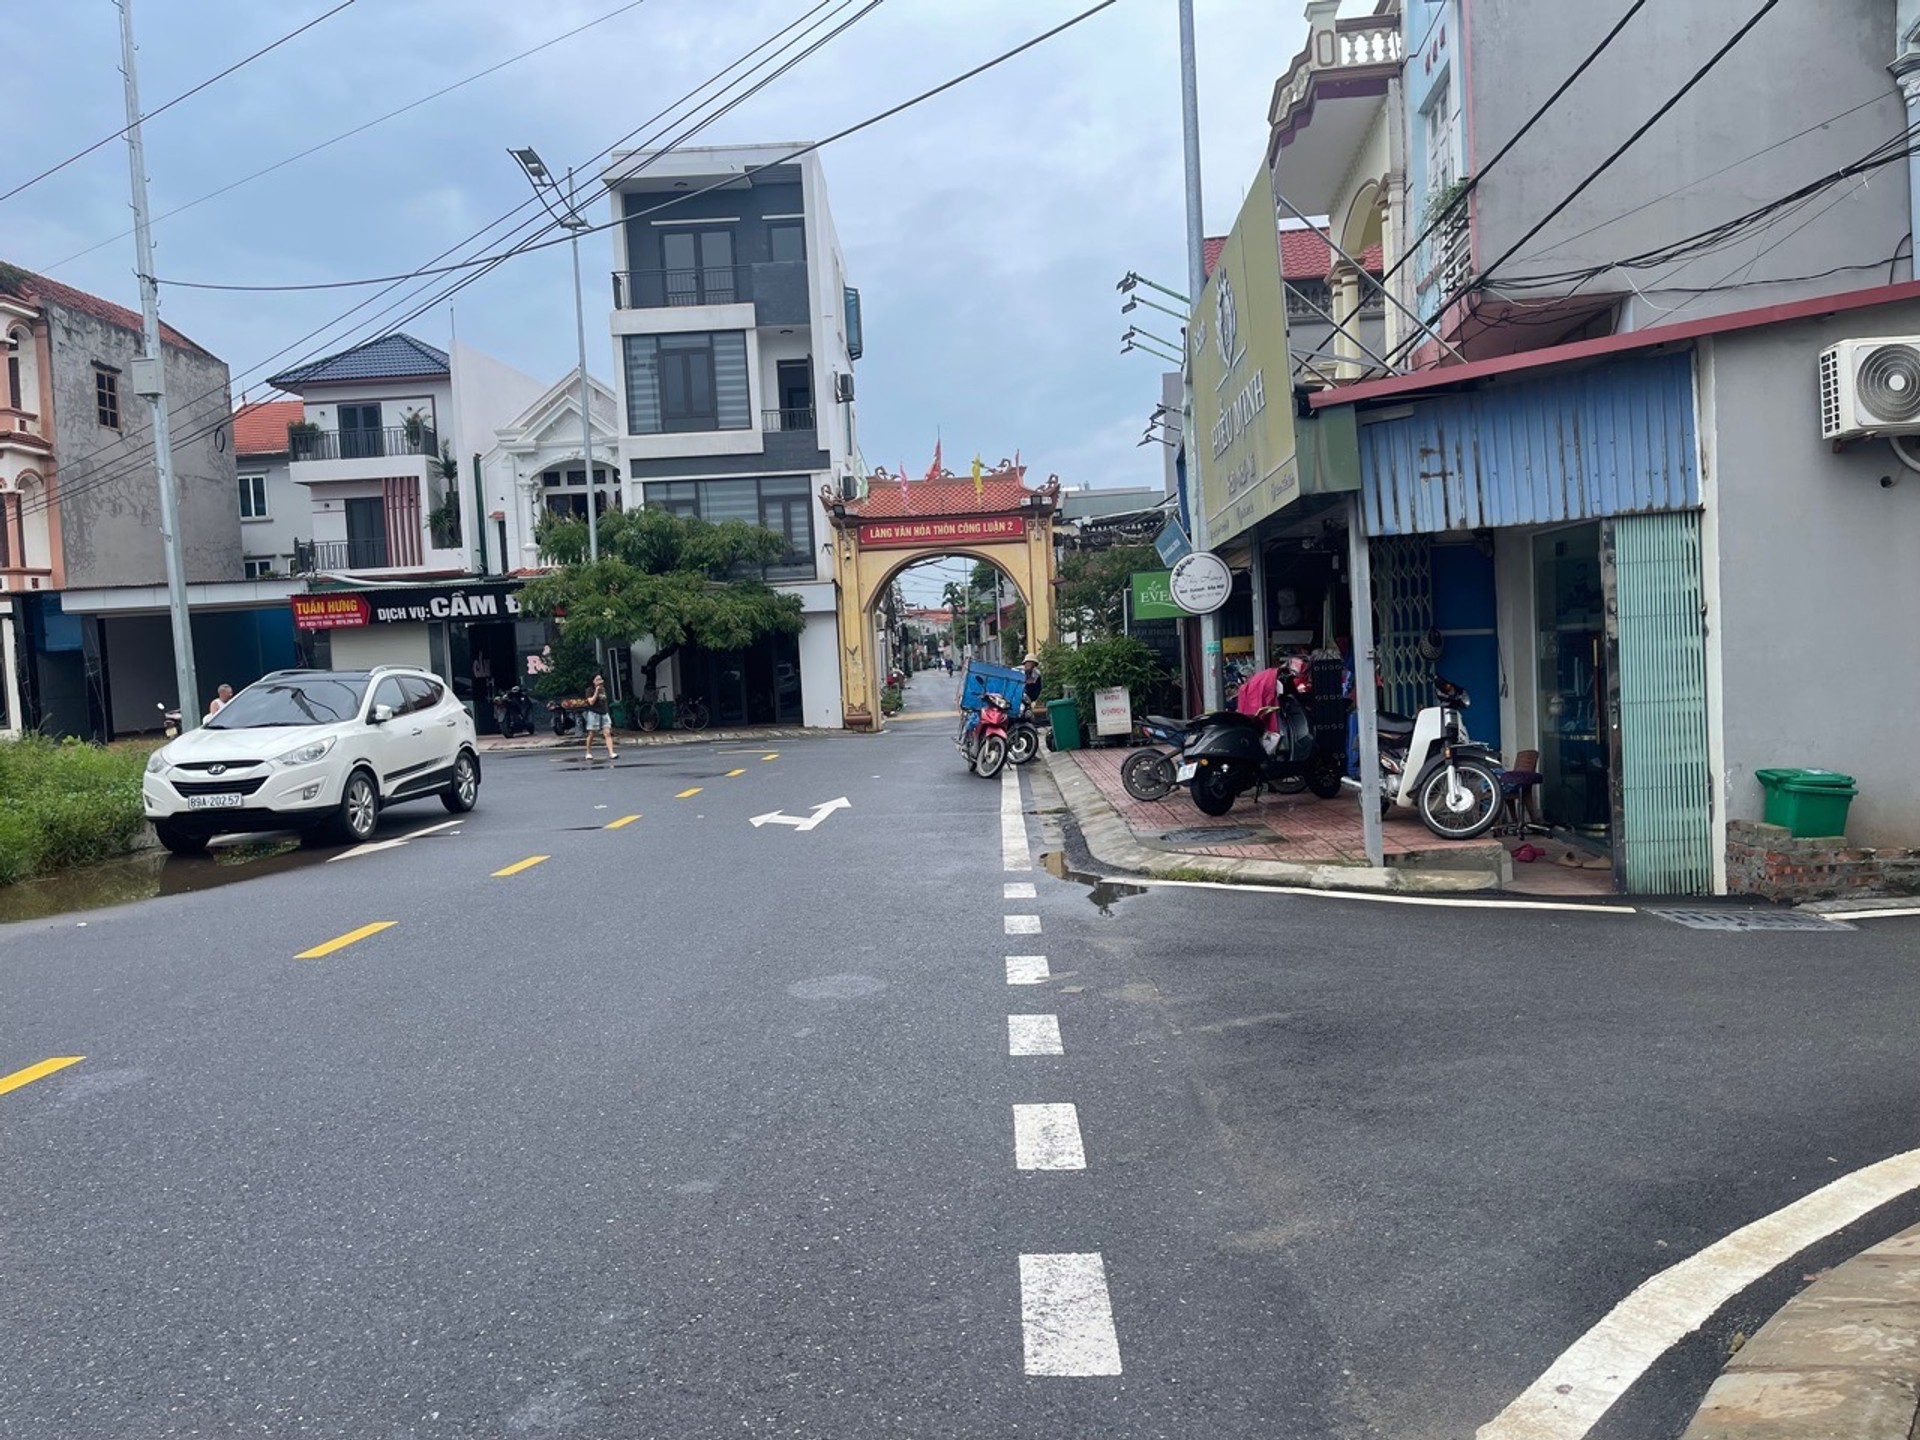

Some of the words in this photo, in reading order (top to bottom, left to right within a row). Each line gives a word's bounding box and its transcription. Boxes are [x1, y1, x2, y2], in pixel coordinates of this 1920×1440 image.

[870, 526, 893, 539] LÀNG
[894, 525, 912, 538] VĂN
[933, 522, 956, 536] THÔN
[957, 521, 981, 534] CÔNG
[982, 520, 1006, 533] LUẬN
[1007, 520, 1014, 531] 2
[377, 606, 407, 623] DỊCH
[408, 605, 430, 621] VỤ:
[430, 590, 497, 618] CẦM
